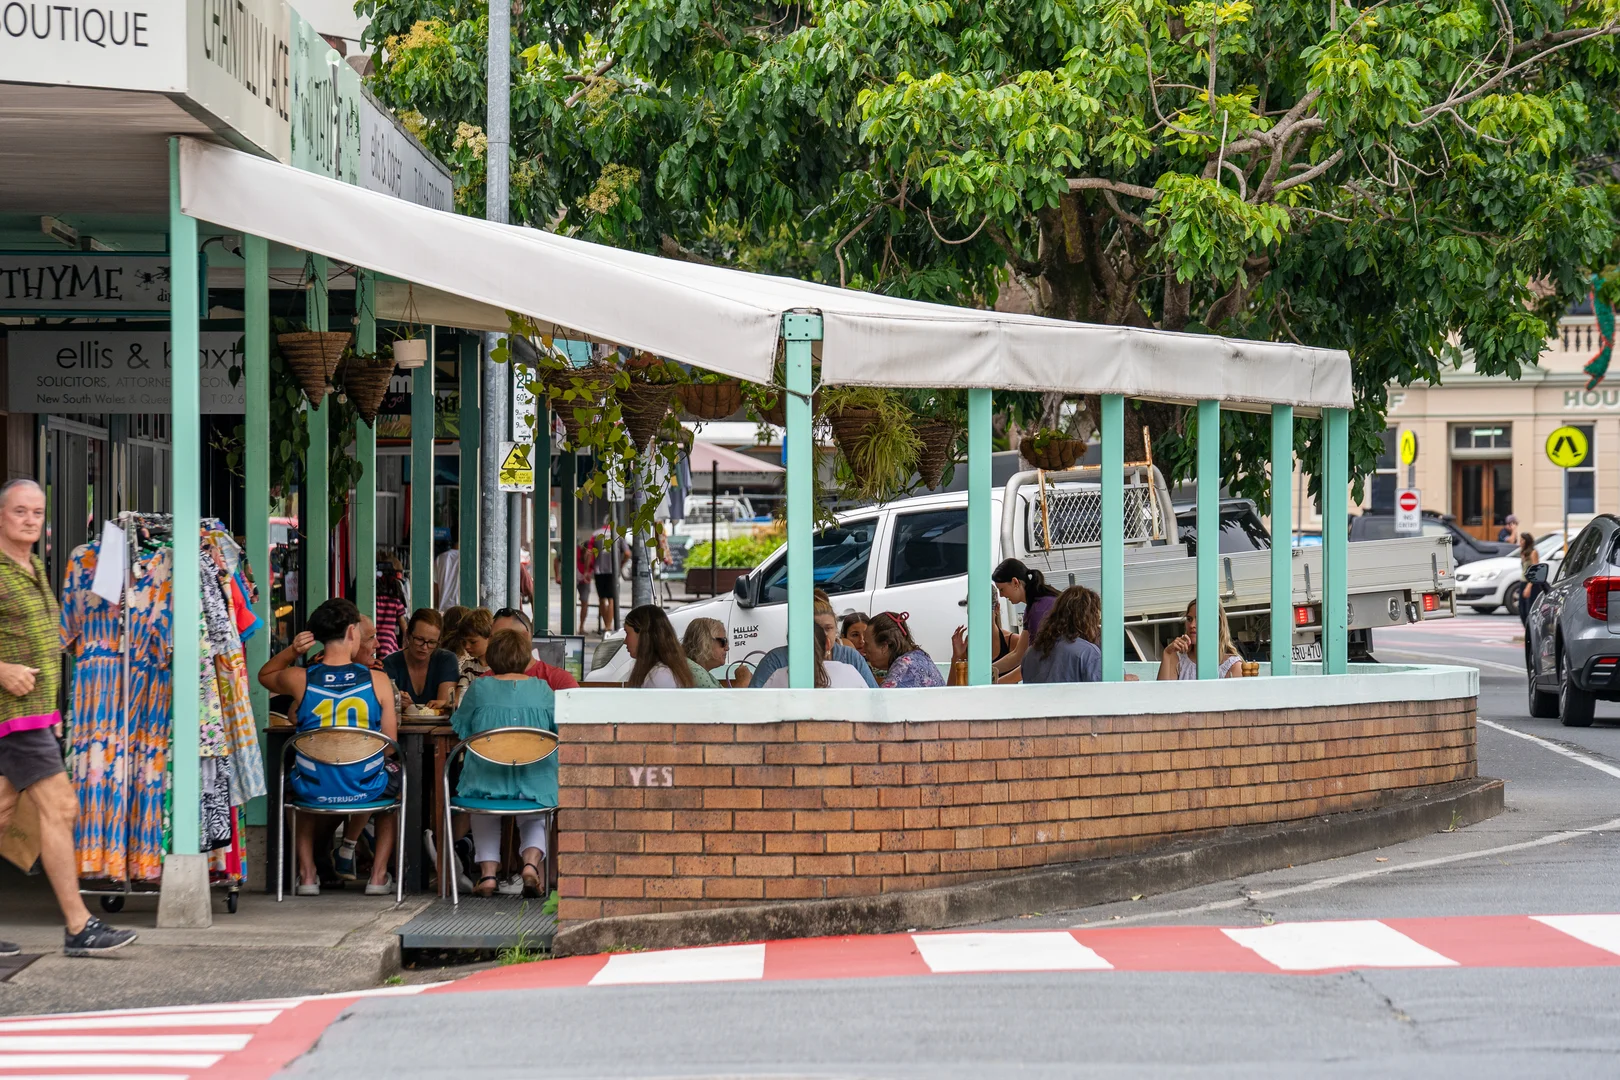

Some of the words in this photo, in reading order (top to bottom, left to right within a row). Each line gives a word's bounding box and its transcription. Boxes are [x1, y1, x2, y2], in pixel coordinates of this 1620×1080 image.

[0, 2, 148, 48] OUTIQUE
[265, 27, 289, 122] LACE
[0, 264, 123, 301] THYME
[56, 340, 113, 369] ellis
[127, 343, 150, 369] &
[36, 376, 110, 389] SOLICITORS,
[37, 394, 60, 404] New
[63, 393, 91, 404] South
[94, 394, 125, 404] Wales
[129, 394, 137, 404] &
[141, 394, 171, 405] Quee
[733, 625, 759, 634] HILUX
[311, 696, 369, 728] 10
[629, 766, 673, 786] YES
